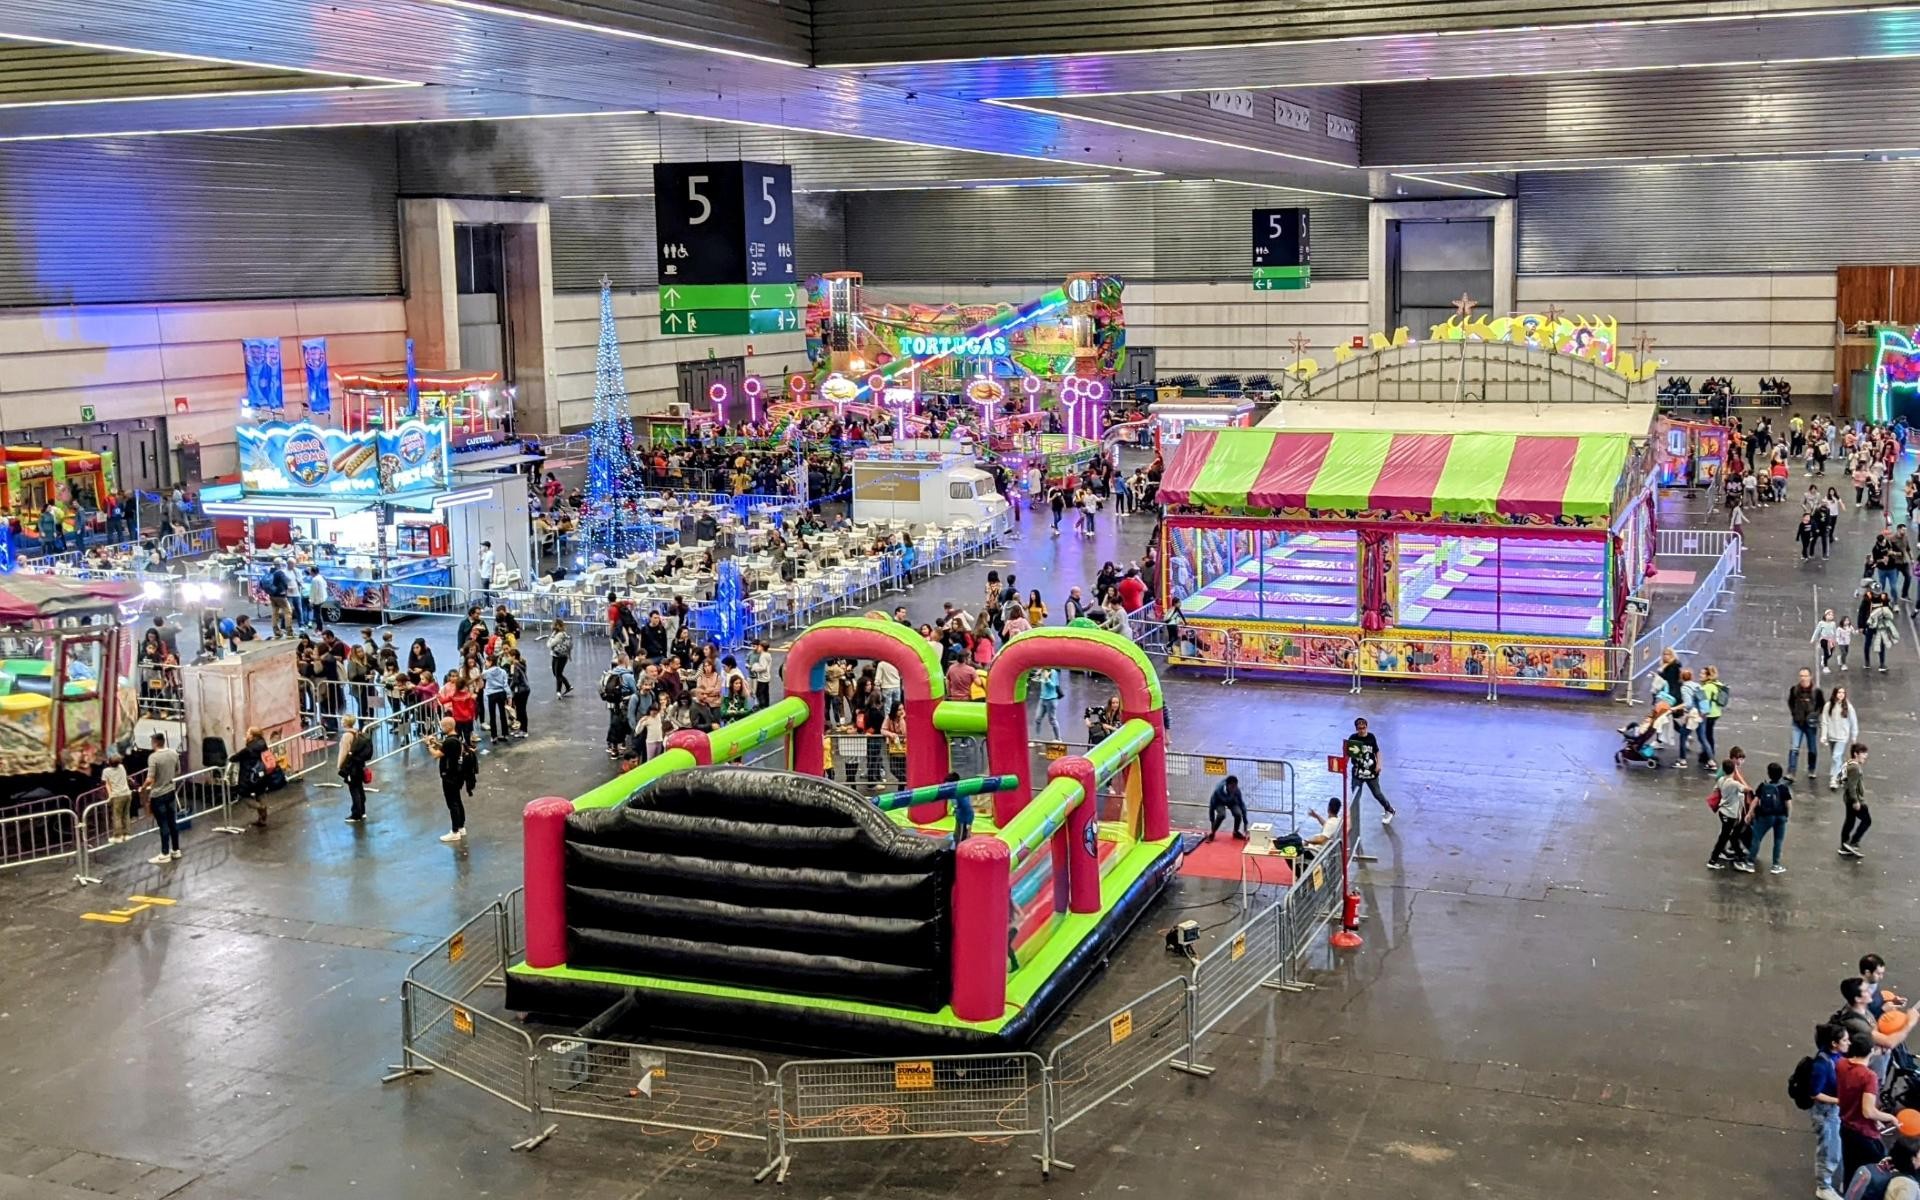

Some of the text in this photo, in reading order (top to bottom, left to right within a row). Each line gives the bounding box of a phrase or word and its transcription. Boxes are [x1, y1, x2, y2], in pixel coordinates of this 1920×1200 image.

[688, 175, 711, 225] 5
[762, 176, 776, 225] 5
[1269, 214, 1282, 239] 5
[751, 261, 757, 276] 3
[899, 336, 1006, 355] TORTUGAS
